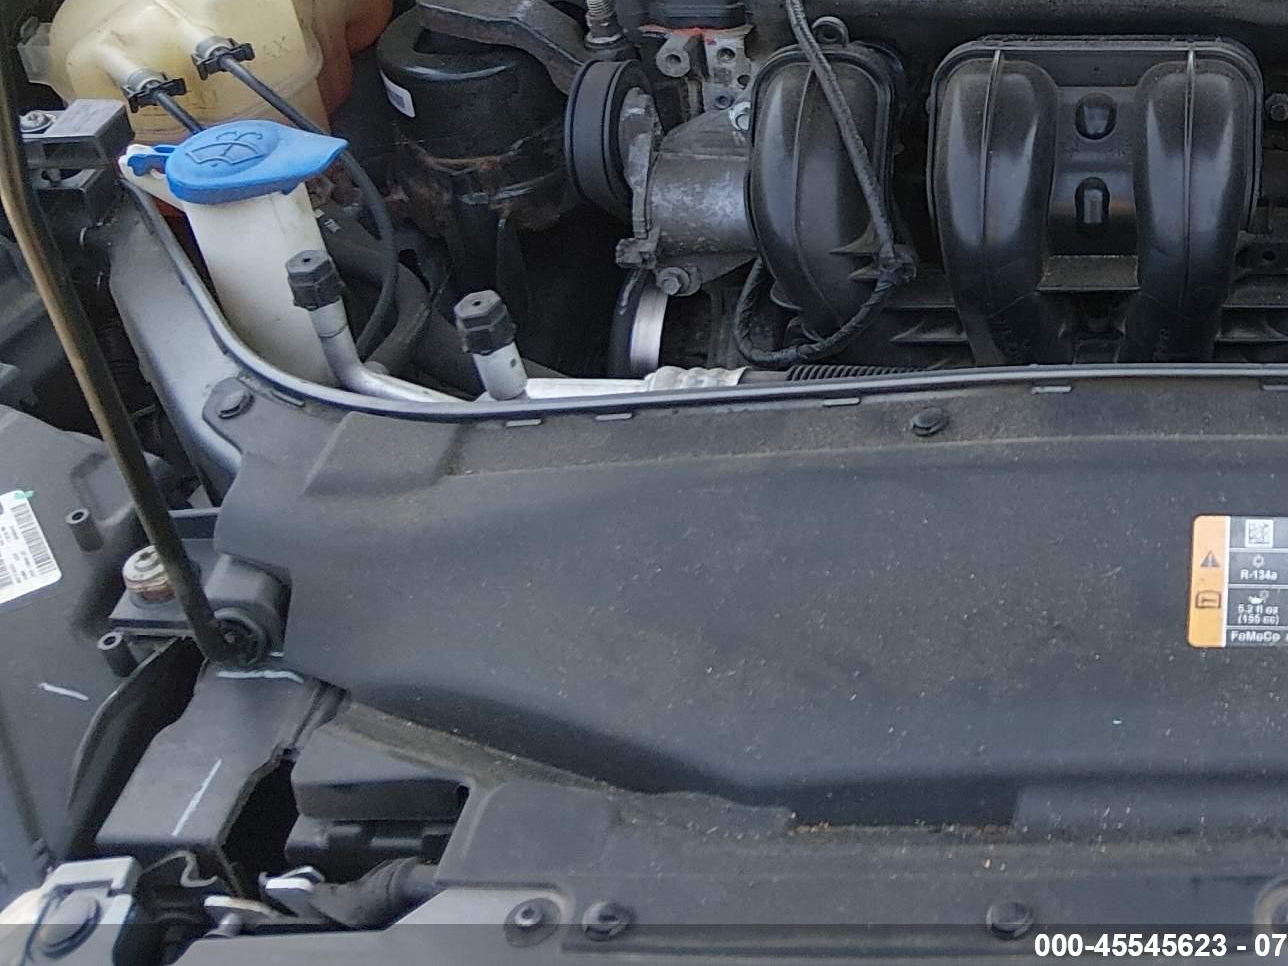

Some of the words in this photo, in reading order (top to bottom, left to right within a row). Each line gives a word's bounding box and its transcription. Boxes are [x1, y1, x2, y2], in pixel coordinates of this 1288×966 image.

[1240, 569, 1278, 581] R-134a
[1265, 606, 1279, 614] oz
[1231, 630, 1281, 642] FoMoCo
